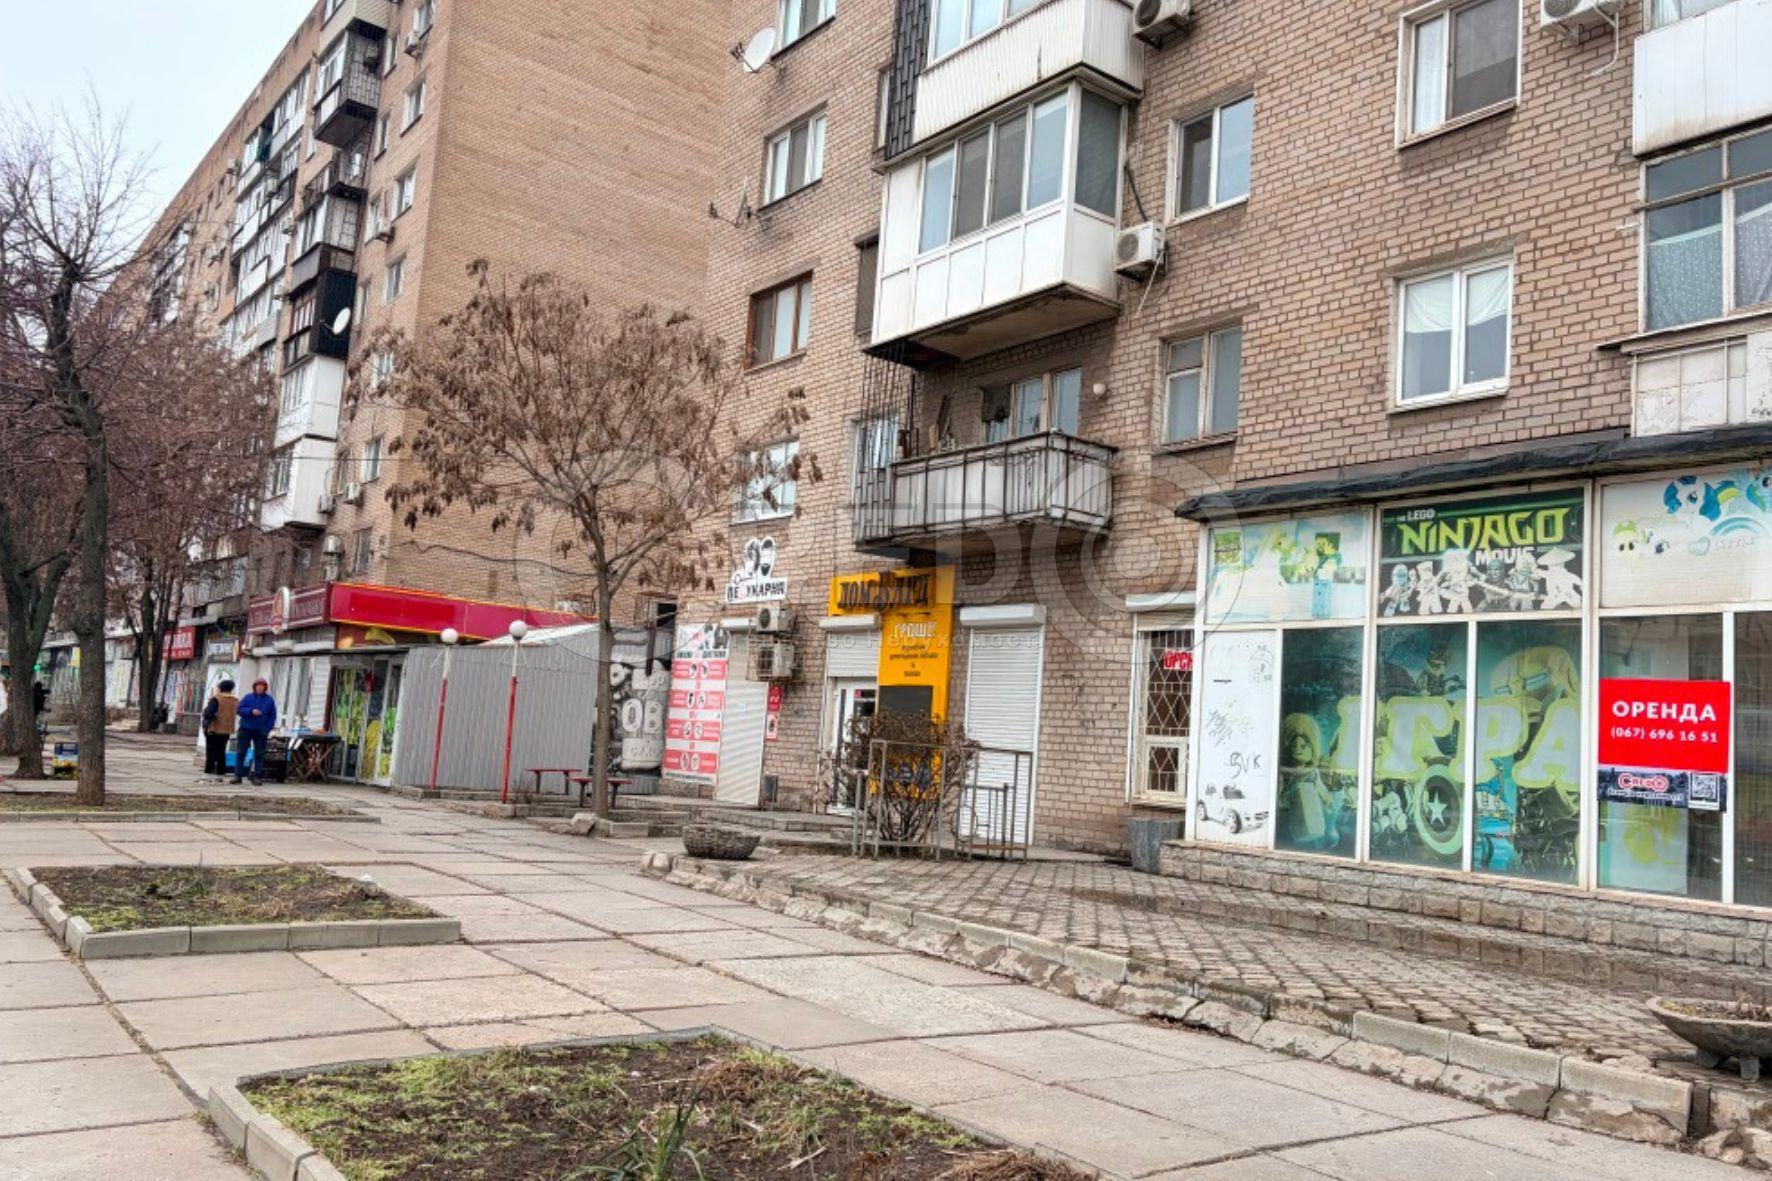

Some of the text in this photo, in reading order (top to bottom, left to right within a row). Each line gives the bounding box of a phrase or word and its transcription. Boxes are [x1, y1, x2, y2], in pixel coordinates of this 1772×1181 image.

[1407, 508, 1436, 521] LEGO
[1397, 507, 1570, 555] NINJAGO
[1612, 700, 1717, 724] ОРЕНДА
[1611, 727, 1718, 743] (067) 696 16 51
